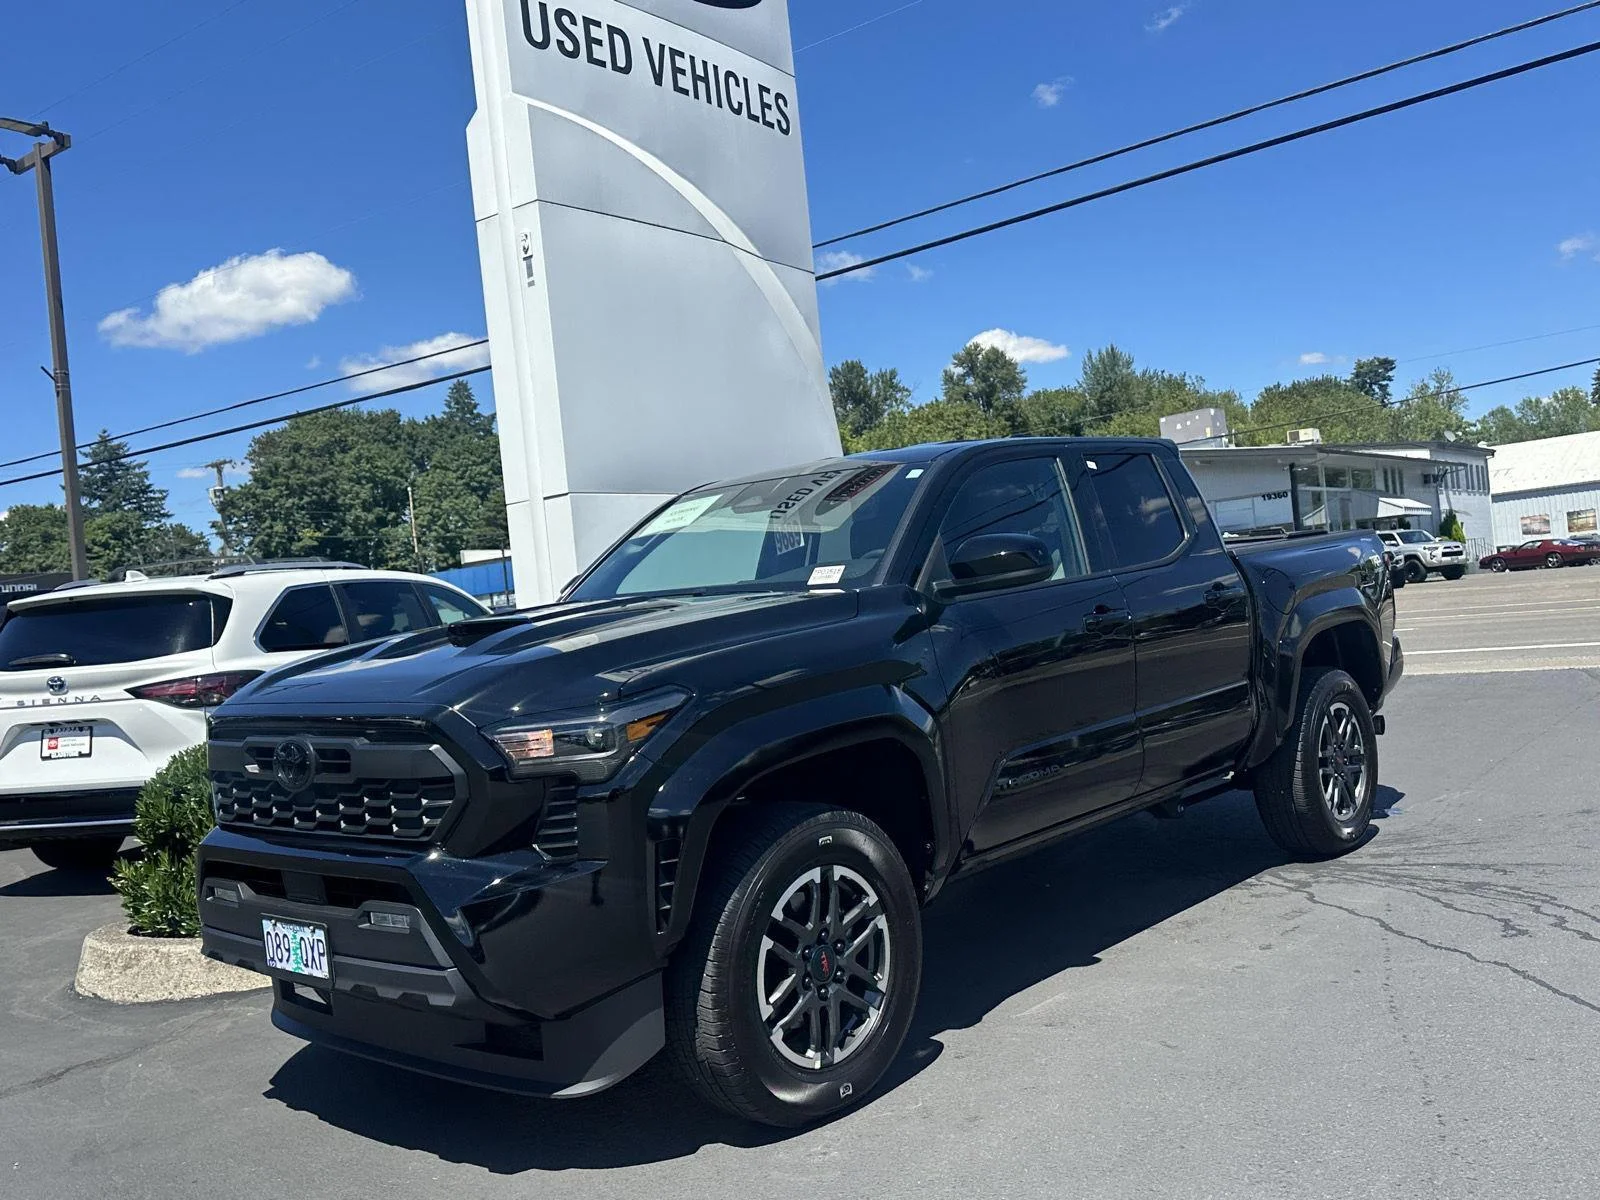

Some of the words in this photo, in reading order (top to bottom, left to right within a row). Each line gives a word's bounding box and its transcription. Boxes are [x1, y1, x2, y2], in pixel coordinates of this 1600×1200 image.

[520, 0, 633, 75] USED
[642, 37, 791, 136] VEHICLES
[16, 694, 101, 707] SIENNA
[299, 936, 326, 971] QXP
